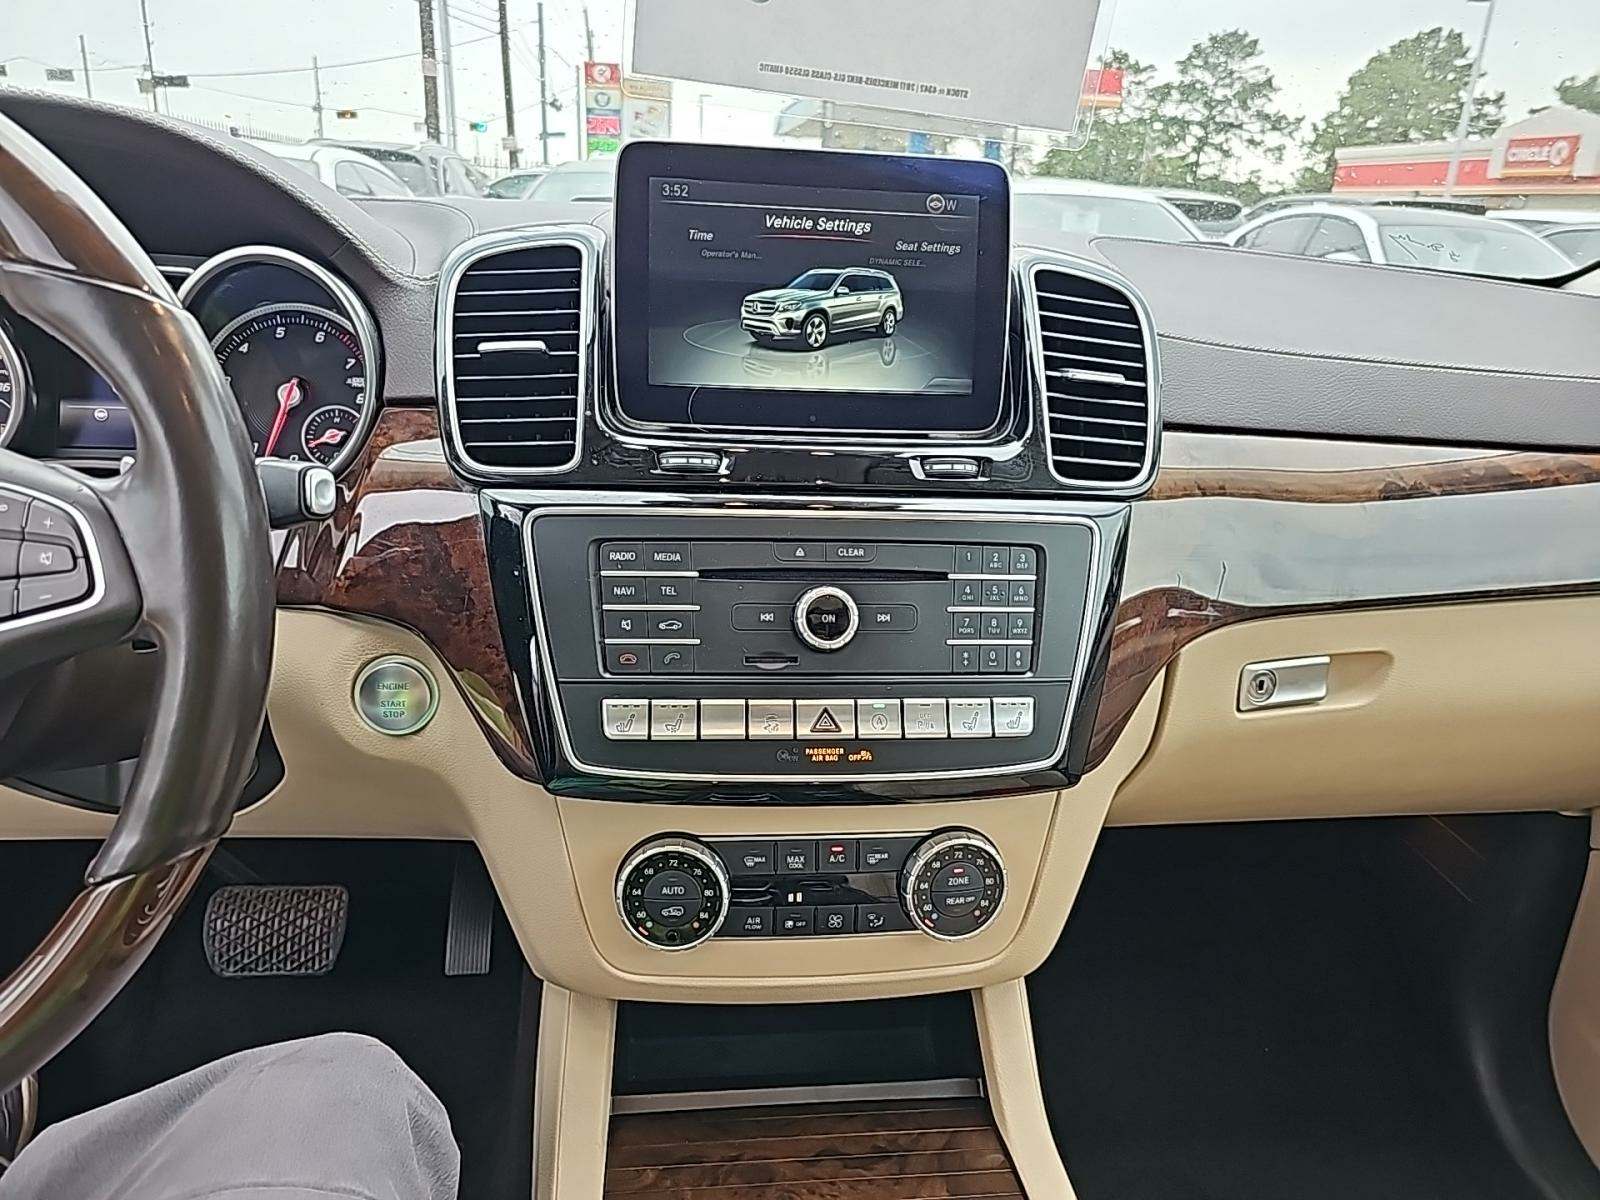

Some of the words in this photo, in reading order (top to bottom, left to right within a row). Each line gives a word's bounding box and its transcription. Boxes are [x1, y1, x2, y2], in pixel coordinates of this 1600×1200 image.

[662, 184, 688, 197] 3:52
[946, 199, 957, 211] W
[765, 214, 814, 230] Vehicle
[817, 216, 872, 235] Settings
[688, 229, 714, 241] Time
[896, 240, 918, 251] Seat
[921, 242, 961, 255] Settings
[701, 249, 739, 259] Operator's
[869, 257, 902, 266] DYNAMIC
[275, 327, 286, 338] 5
[315, 332, 325, 343] 6
[238, 342, 248, 353] 4
[345, 358, 356, 370] 7
[609, 551, 636, 561] RADIO
[654, 552, 682, 562] MEDIA
[838, 548, 865, 557] CLEAR
[966, 552, 971, 561] 1
[992, 553, 999, 561] 2
[1019, 554, 1026, 562] 3
[613, 587, 635, 596] NAVI
[661, 587, 677, 596] TEL
[964, 585, 970, 594] 4
[992, 586, 998, 594] 5
[1018, 586, 1024, 594] 6
[821, 613, 836, 623] ON
[963, 618, 970, 627] 7
[991, 618, 998, 627] 8
[1017, 619, 1023, 627] 9
[989, 650, 996, 659] 0
[377, 682, 410, 691] ENGINE
[380, 700, 407, 708] START
[382, 710, 405, 718] STOP
[786, 855, 805, 864] MAX
[829, 854, 846, 863] A/C
[954, 851, 963, 859] 72
[668, 859, 679, 867] 72
[931, 861, 941, 869] 68
[976, 858, 985, 867] 76
[644, 868, 654, 876] 68
[693, 868, 702, 876] 76
[948, 877, 970, 886] ZONE
[985, 877, 995, 885] 80
[661, 886, 685, 895] AUTO
[919, 882, 929, 890] 64
[704, 889, 714, 897] 80
[945, 896, 965, 905] REAR
[980, 899, 989, 907] 84
[923, 903, 933, 911] 60
[636, 911, 646, 919] 60
[699, 911, 709, 919] 84
[747, 917, 761, 925] AIR
